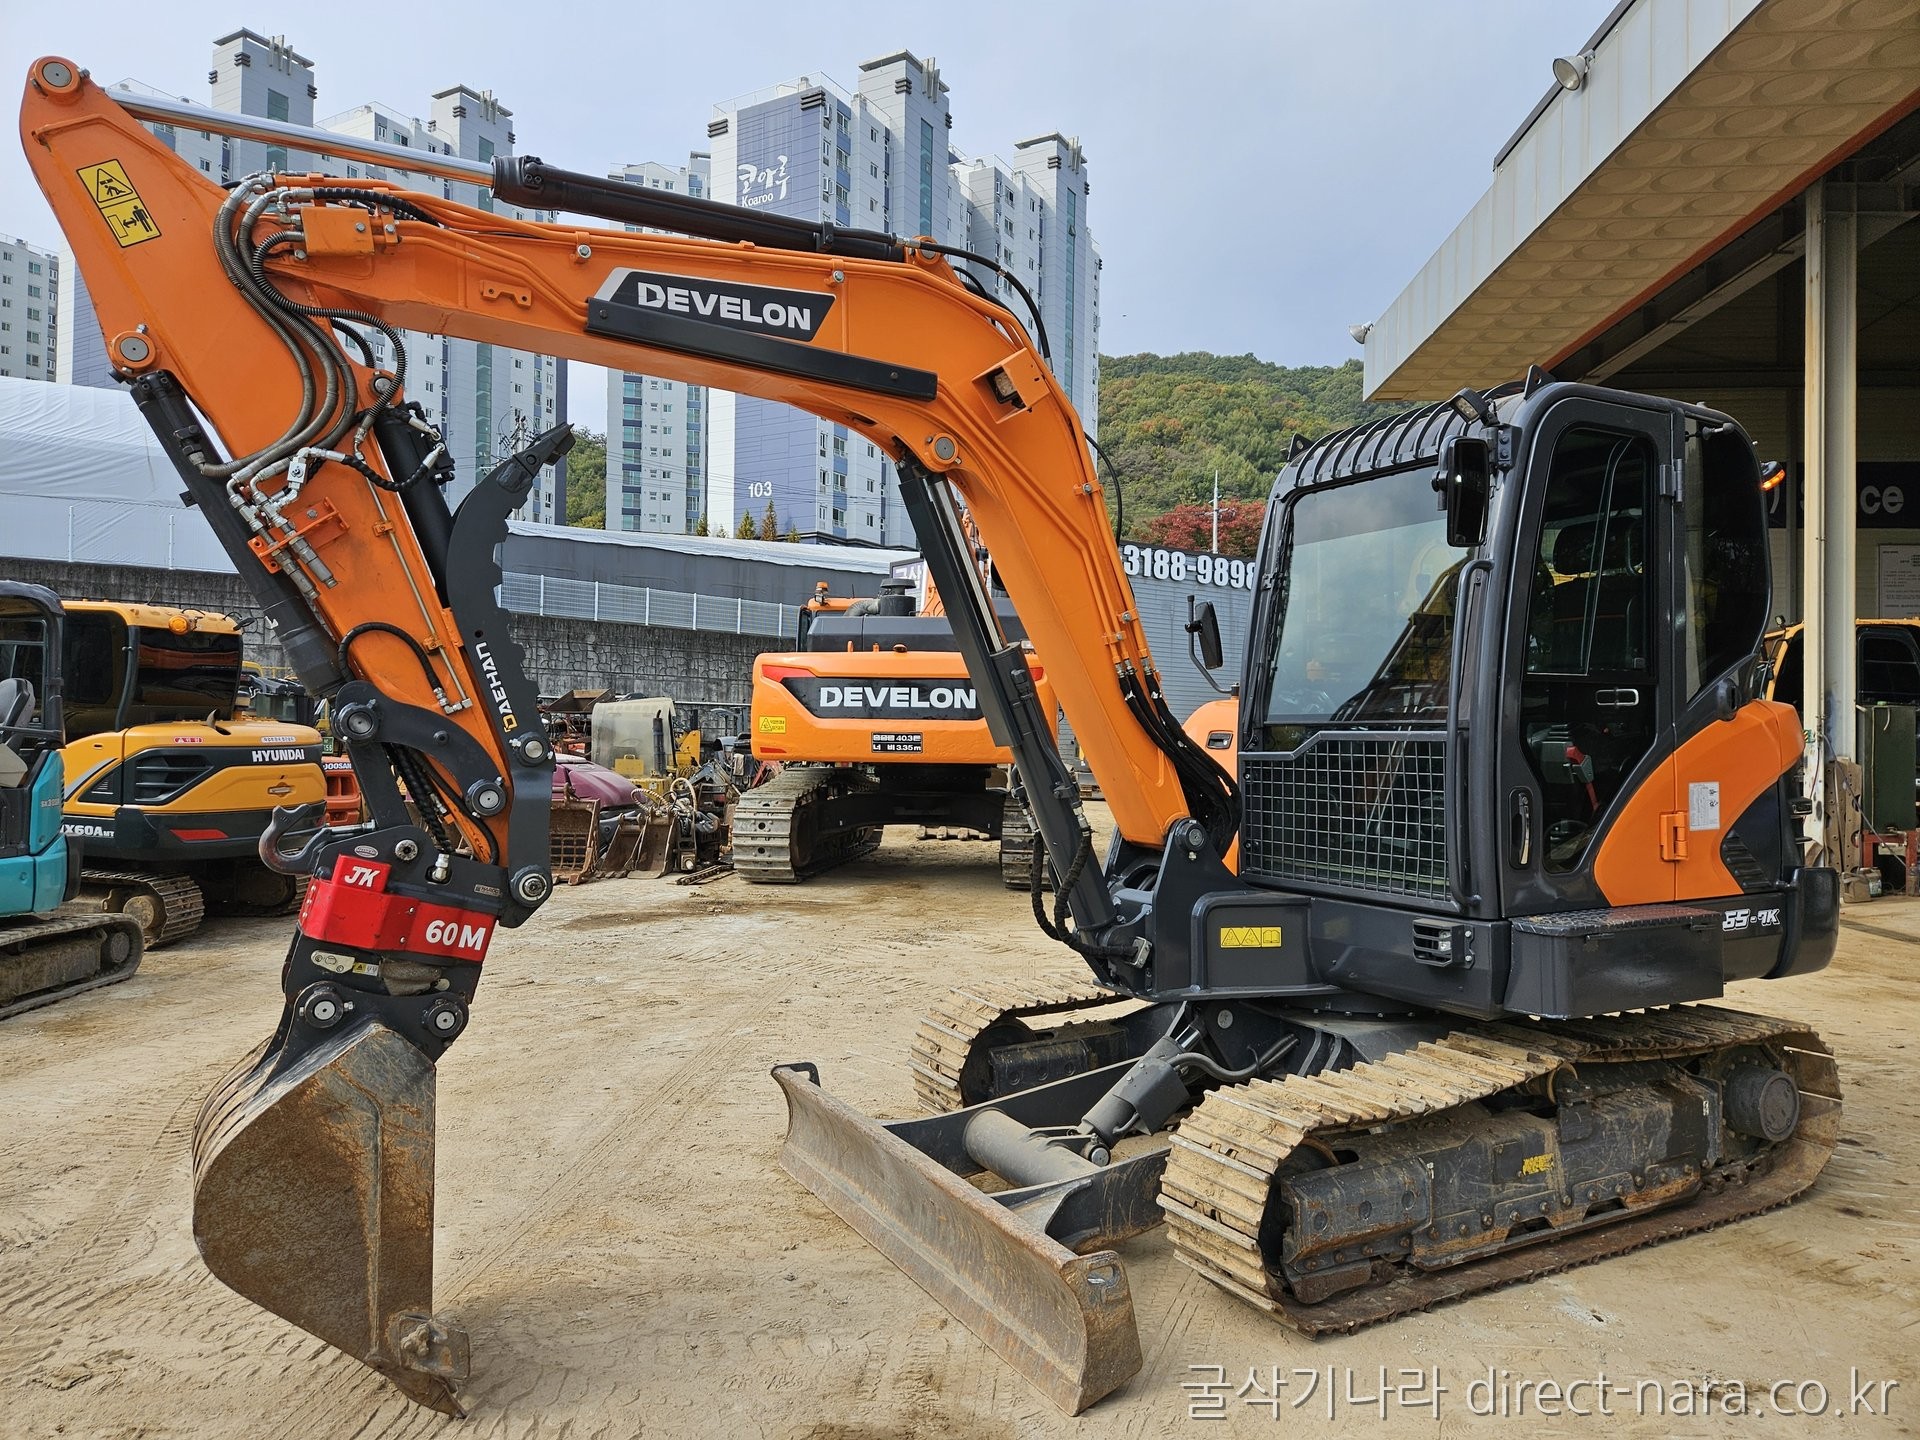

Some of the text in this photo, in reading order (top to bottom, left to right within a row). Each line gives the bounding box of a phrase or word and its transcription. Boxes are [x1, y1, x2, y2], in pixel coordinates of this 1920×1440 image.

[738, 155, 790, 200] 코아루
[741, 193, 774, 207] Koaroo
[637, 281, 811, 331] DEVELON
[748, 481, 772, 498] 103
[1120, 545, 1256, 590] 3188-9898
[475, 641, 518, 733] DAEHAN
[820, 686, 977, 709] DEVELON
[252, 749, 305, 763] HYUNDAI
[344, 865, 380, 887] JK
[425, 919, 486, 951] 60M
